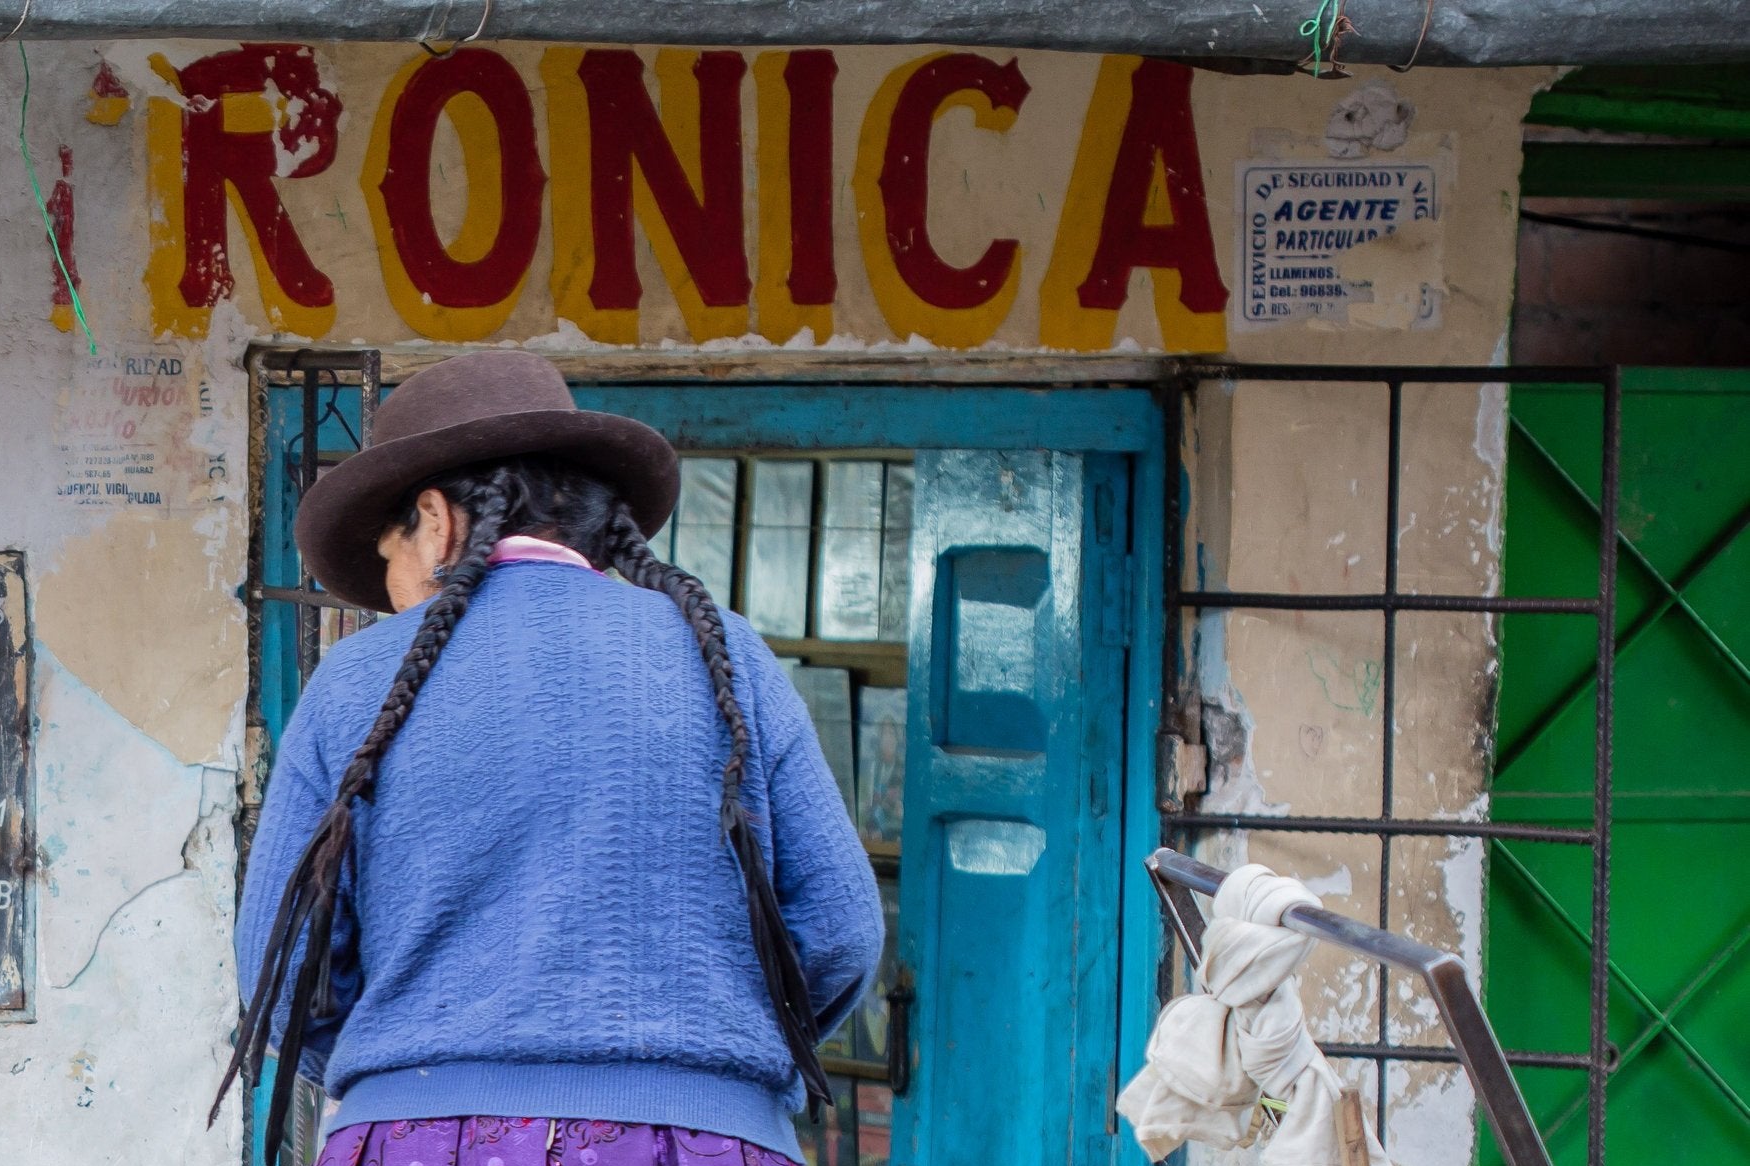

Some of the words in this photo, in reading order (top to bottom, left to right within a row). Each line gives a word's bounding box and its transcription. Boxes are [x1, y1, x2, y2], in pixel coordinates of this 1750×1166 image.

[1252, 213, 1267, 317] SERVICIO
[1288, 172, 1392, 188] SEGURIDAD
[1273, 199, 1401, 222] AGENTE
